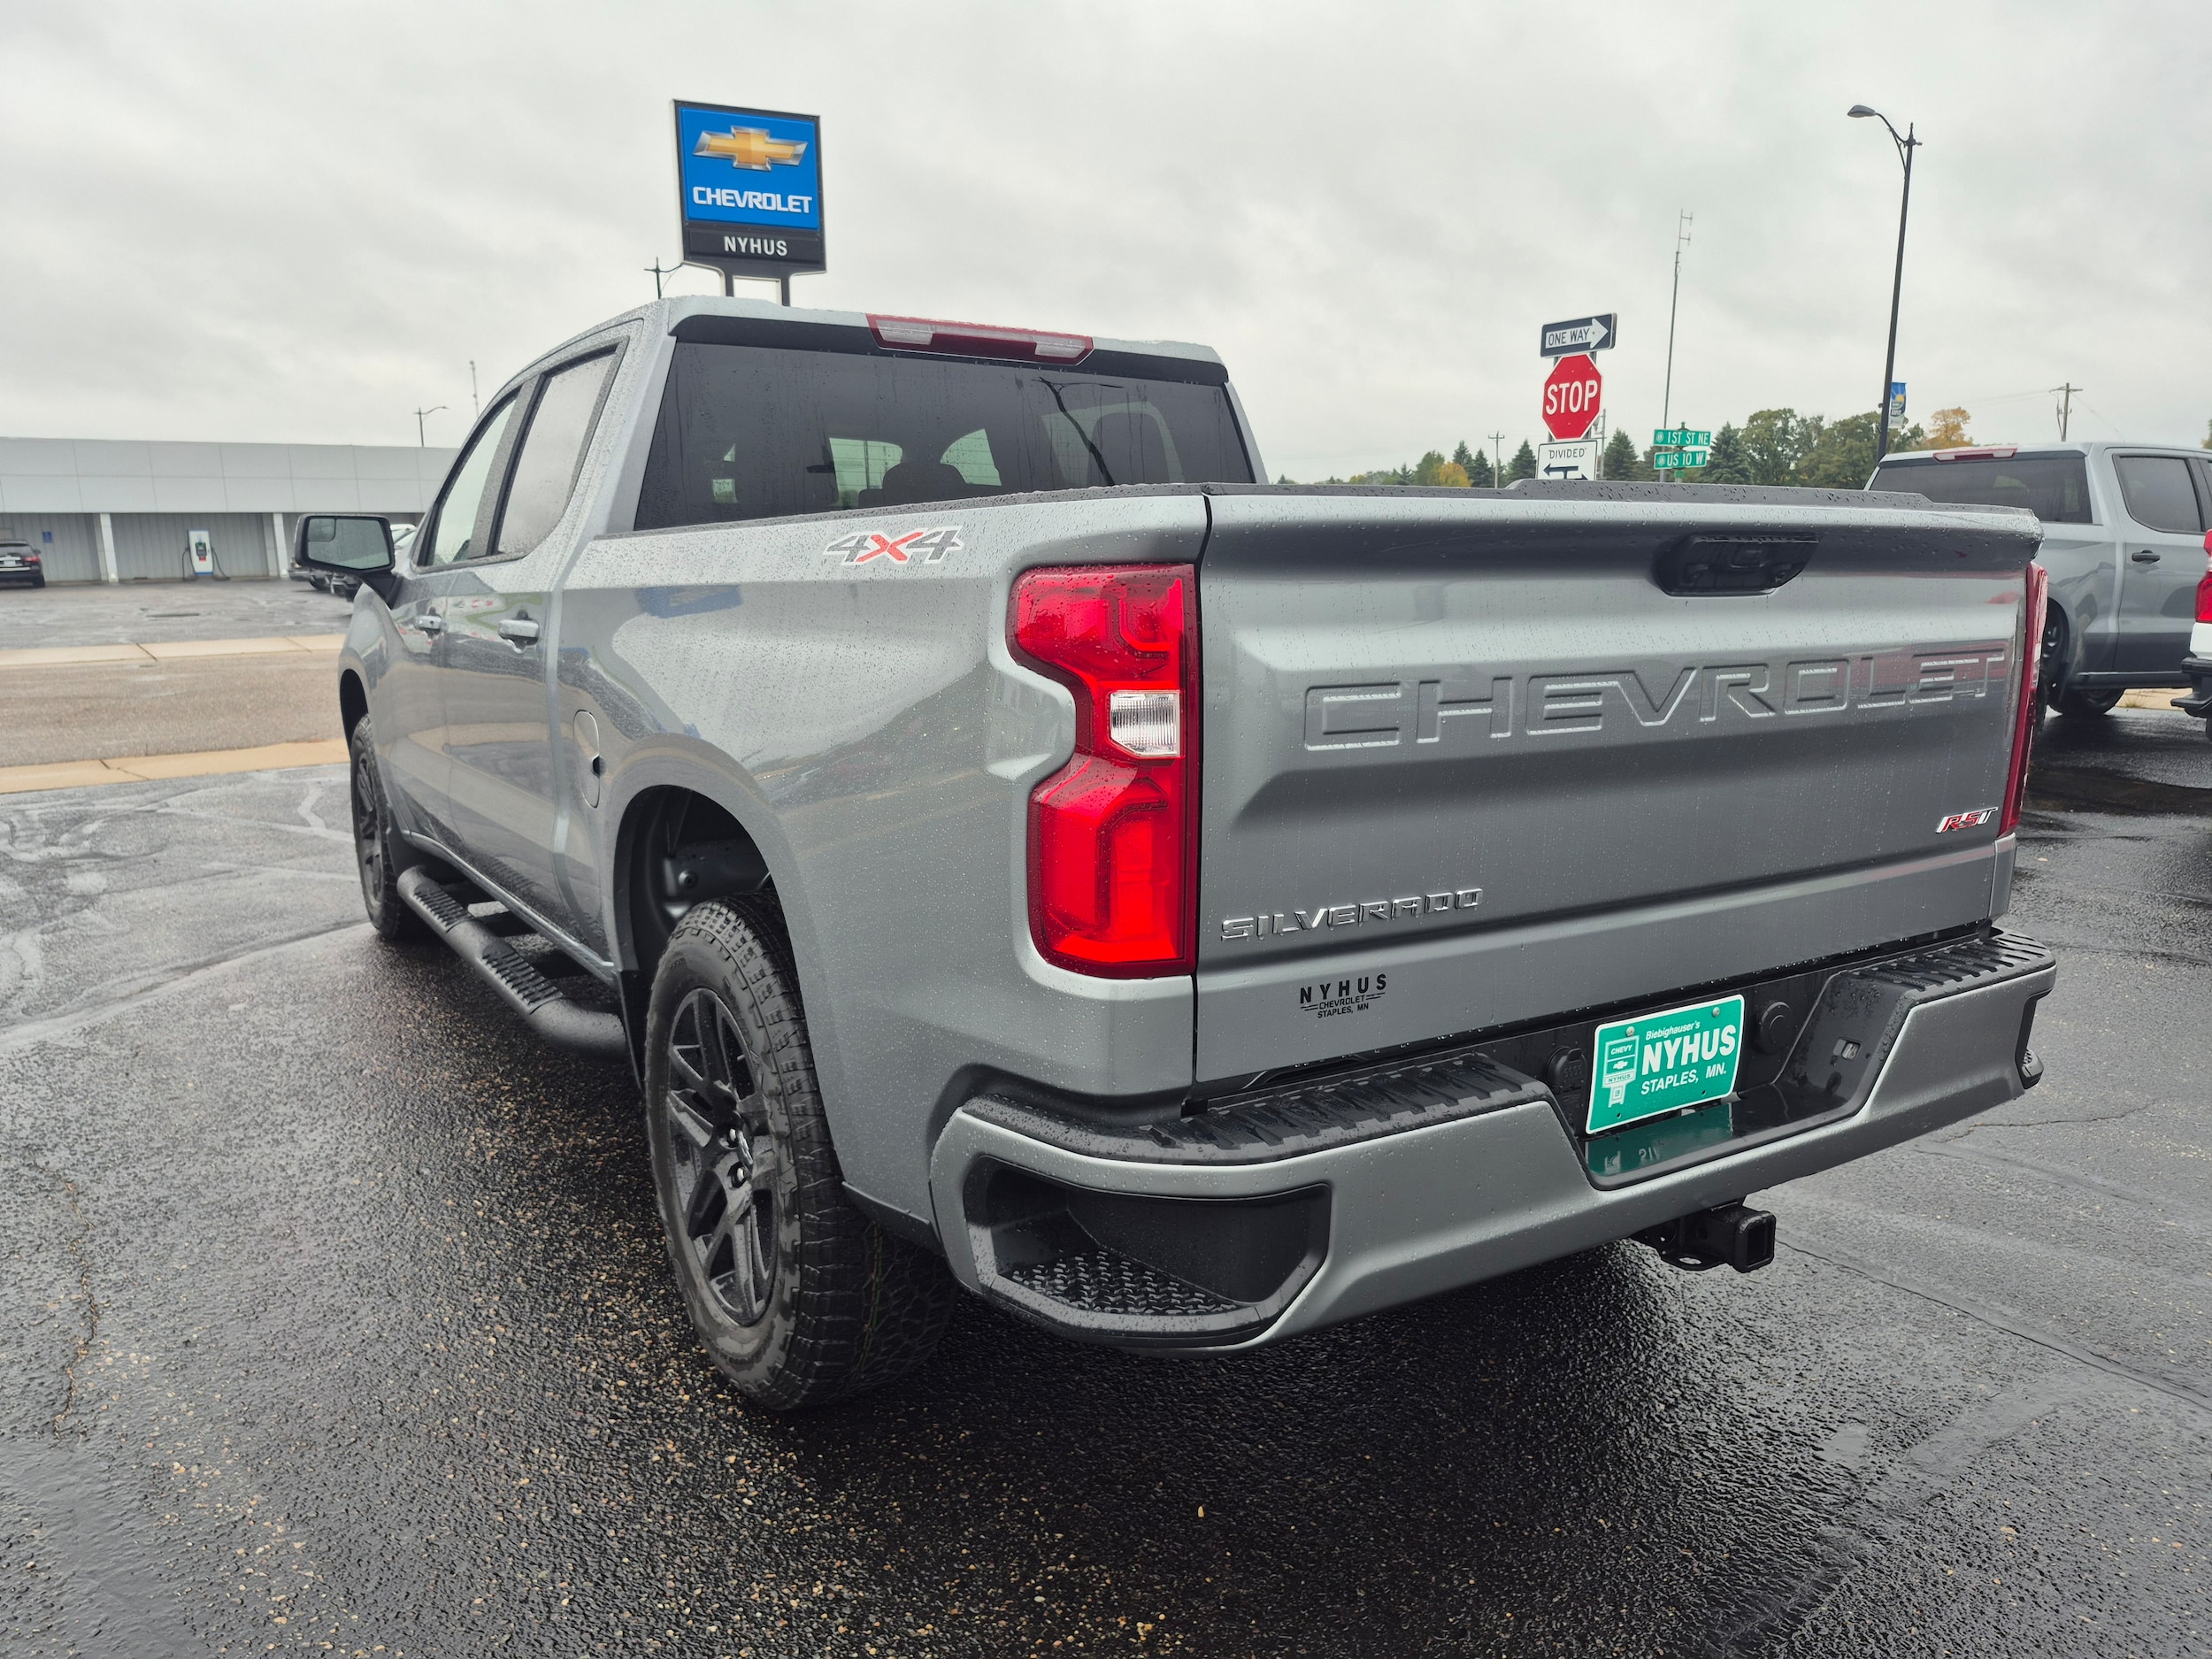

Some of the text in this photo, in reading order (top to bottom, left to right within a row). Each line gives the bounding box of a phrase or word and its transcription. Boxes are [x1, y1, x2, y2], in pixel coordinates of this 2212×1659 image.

[693, 187, 812, 213] CHEVROLET
[724, 236, 787, 256] NYHUS
[1548, 327, 1590, 346] ONE WAY
[1546, 380, 1598, 415] STOP
[1686, 432, 1695, 444] ST
[1698, 433, 1709, 445] NE
[1667, 452, 1704, 466] US 10 W
[1304, 649, 2006, 751] CHEVROLET
[1936, 807, 1999, 833] RST
[1221, 887, 1484, 942] SILVERADO
[1300, 973, 1386, 1004] NYHUS
[1317, 1002, 1369, 1018] STAPLES, MN
[1319, 995, 1365, 1010] CHEVROLET
[1645, 1020, 1701, 1041] Biebighauser's
[1610, 1044, 1633, 1056] CHEVY
[1641, 1025, 1737, 1076] NYHUS
[1608, 1072, 1632, 1084] NYHUS
[1640, 1062, 1727, 1095] STAPLES, MN.
